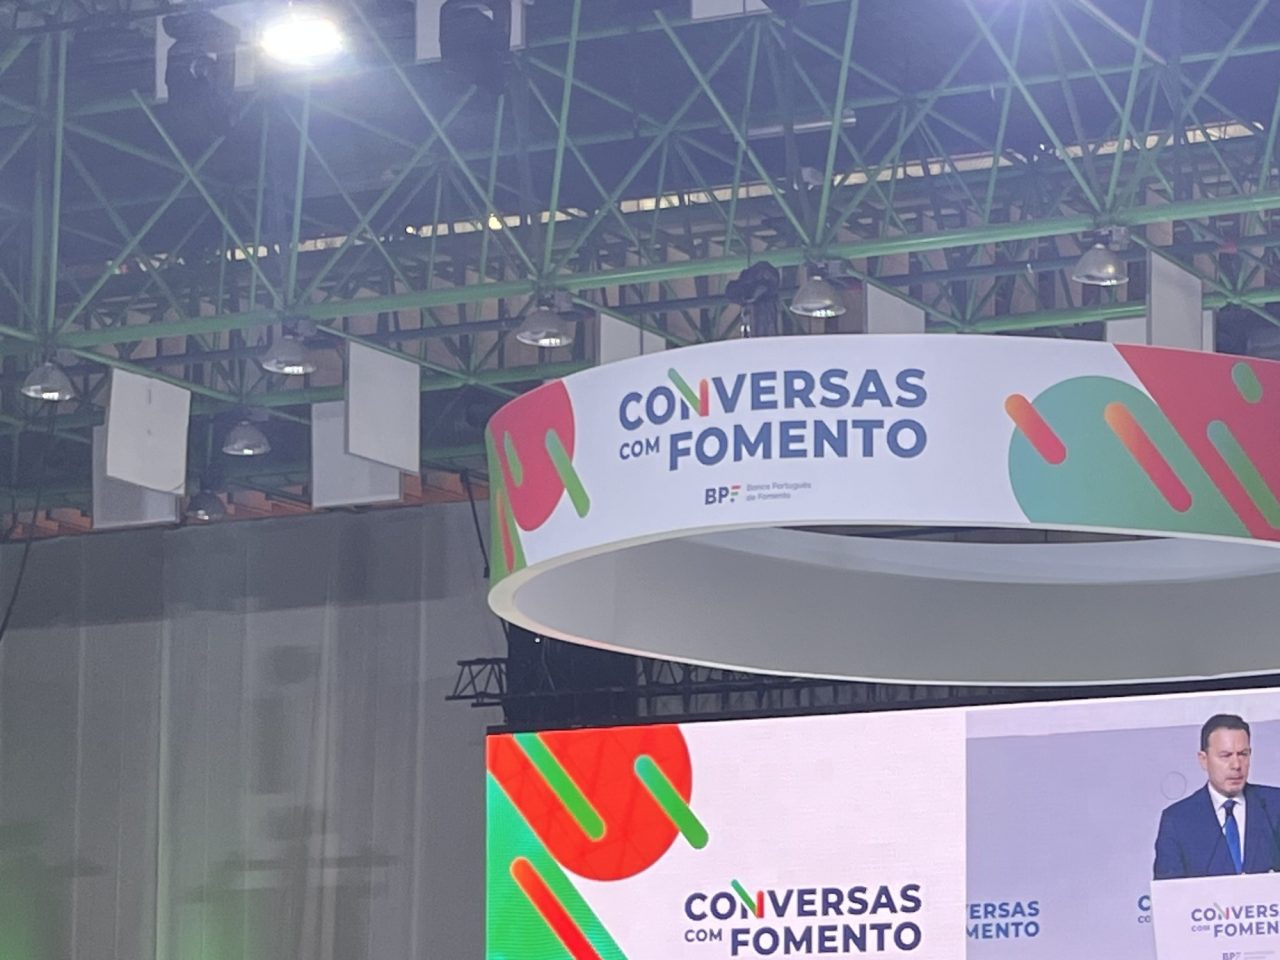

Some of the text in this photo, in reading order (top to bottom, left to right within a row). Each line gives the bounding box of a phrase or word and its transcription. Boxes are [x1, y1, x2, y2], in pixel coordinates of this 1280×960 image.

[618, 367, 928, 431] CONVERSAS
[618, 418, 928, 471] COM FOMENTO
[684, 879, 922, 922] CONVERSAS
[966, 901, 1040, 920] ERSAS
[684, 921, 922, 957] COM FOMENTO
